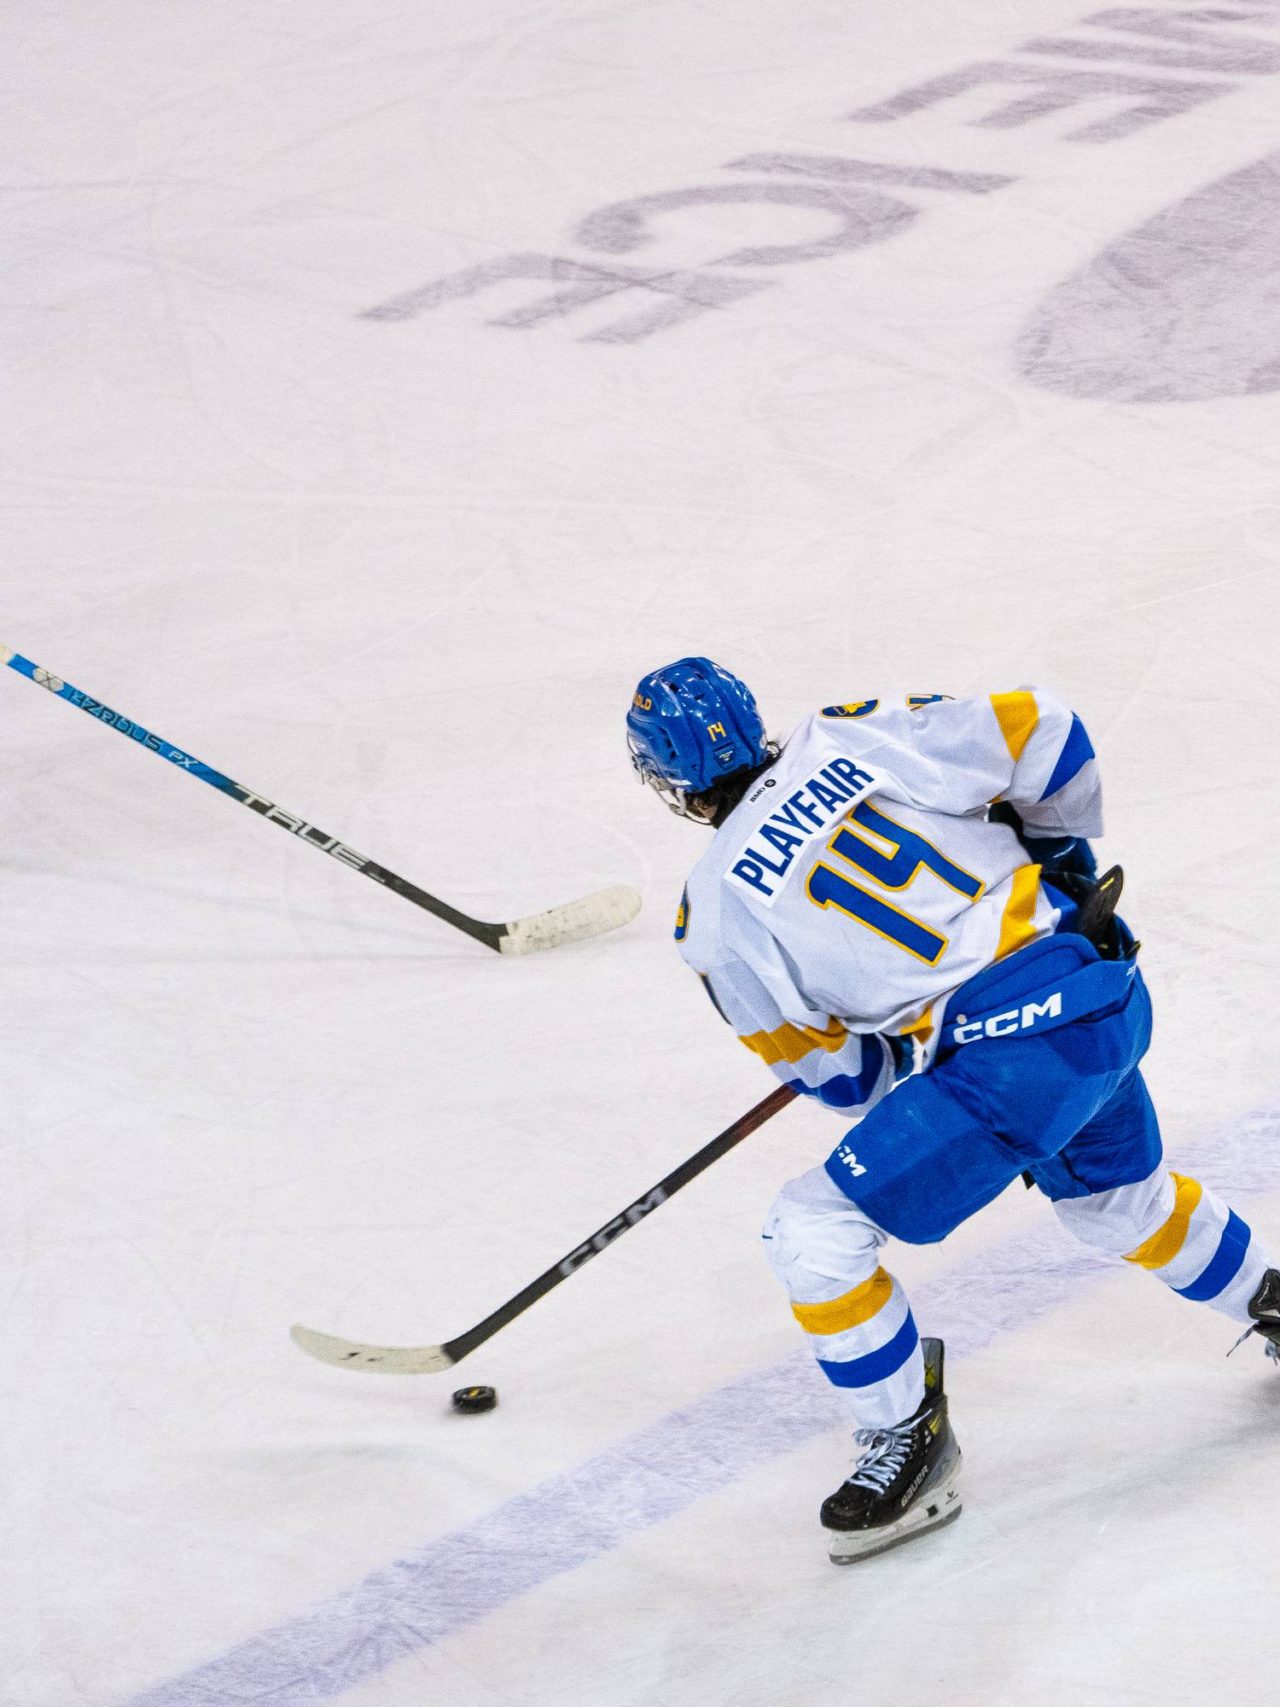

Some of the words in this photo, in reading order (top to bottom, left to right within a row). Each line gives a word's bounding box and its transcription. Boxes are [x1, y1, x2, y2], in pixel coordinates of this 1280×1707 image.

[358, 152, 1018, 343] ICE
[168, 749, 199, 769] PX
[706, 721, 727, 742] 14
[234, 784, 371, 870] TRUE
[731, 757, 875, 897] PLAYFAIR
[749, 786, 766, 803] BMO
[804, 800, 987, 968] 14
[953, 992, 1062, 1045] CCM
[559, 1185, 668, 1276] CCM
